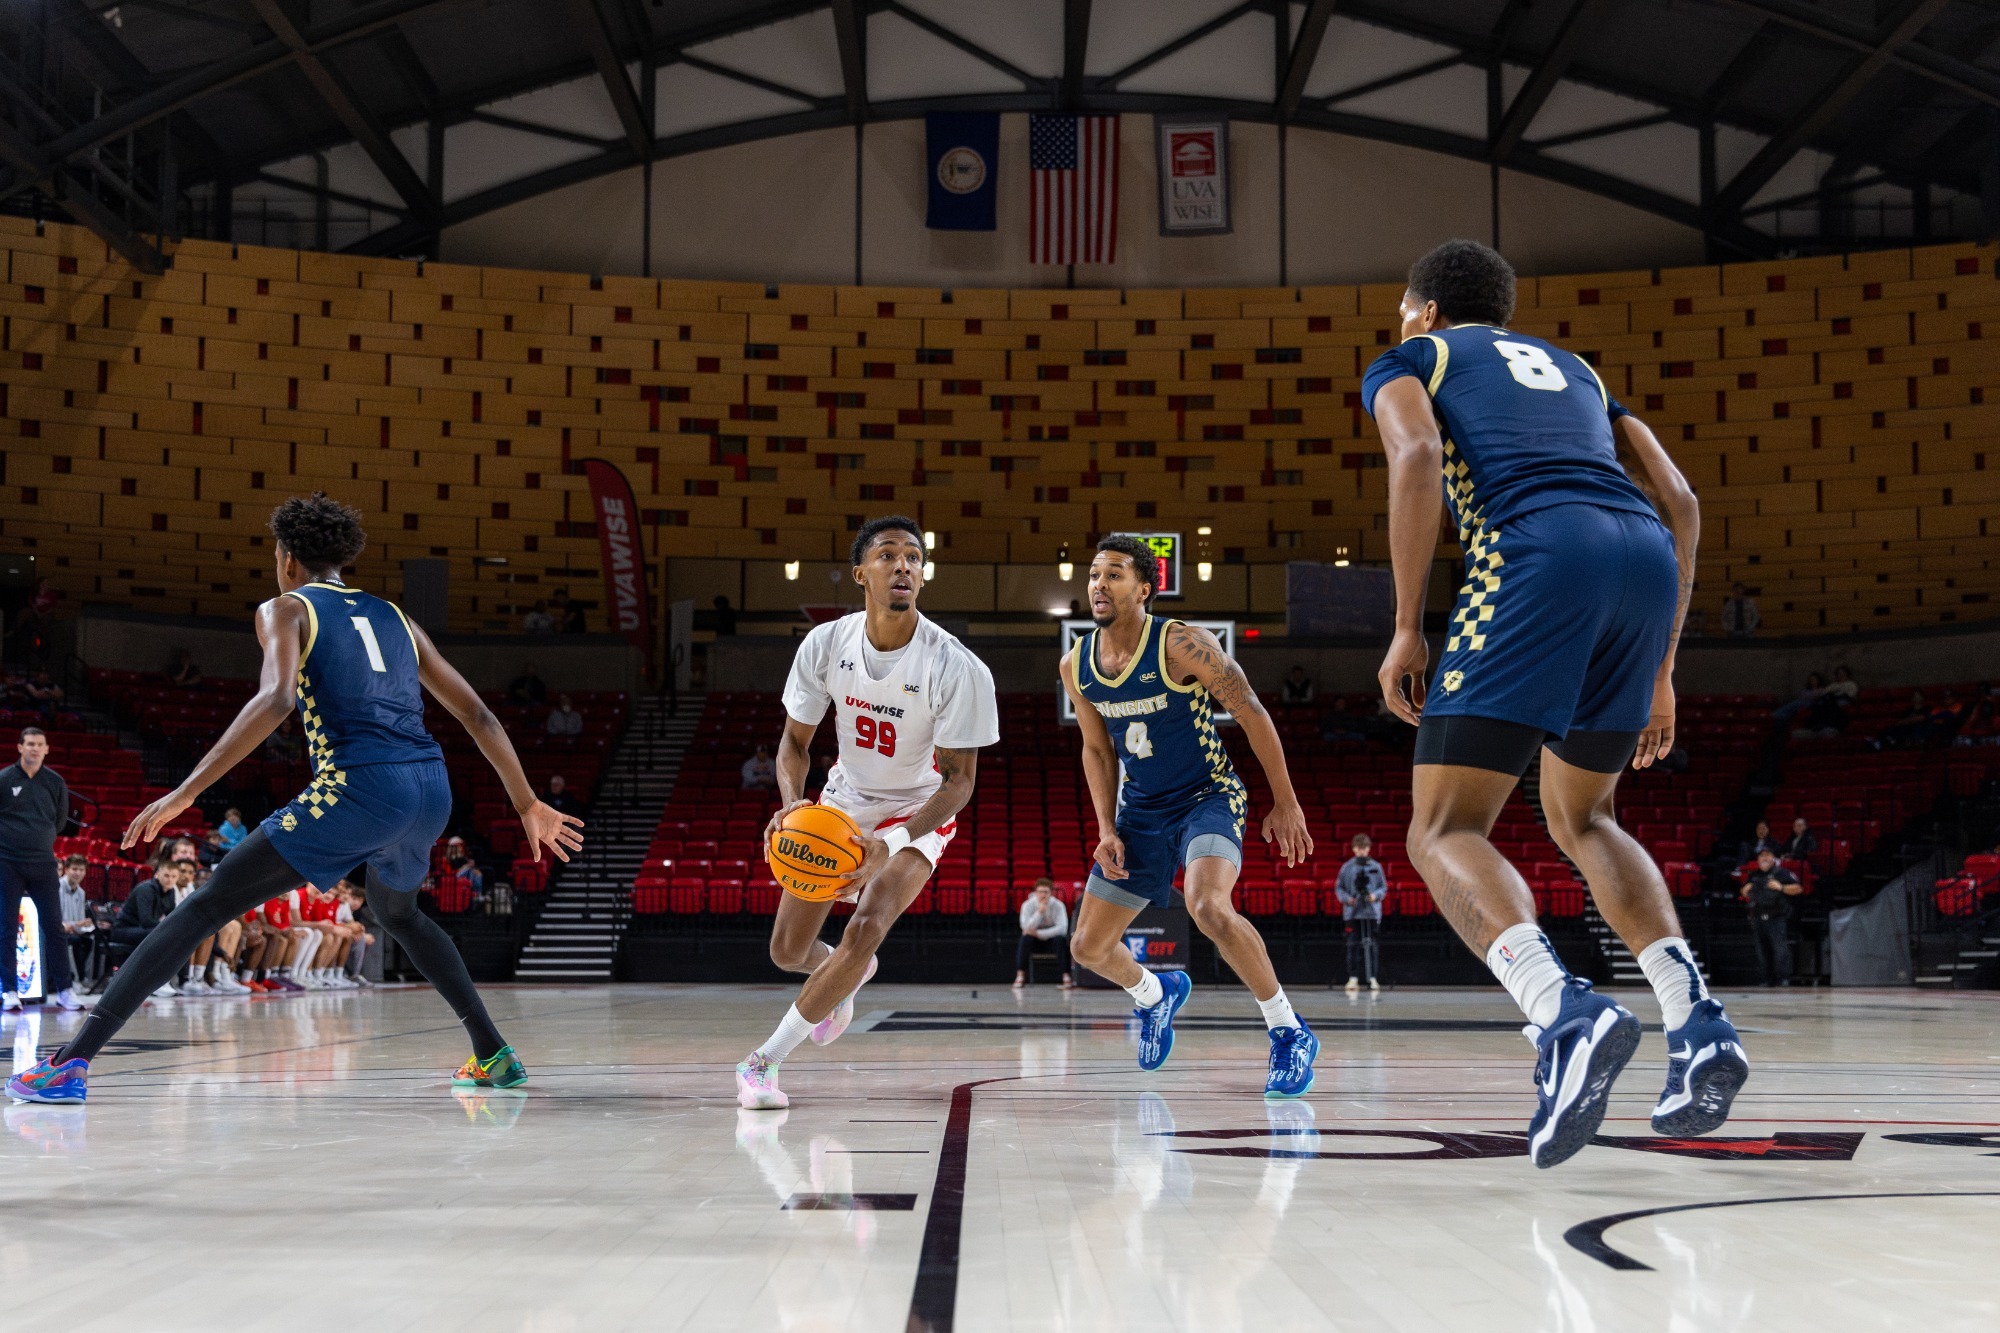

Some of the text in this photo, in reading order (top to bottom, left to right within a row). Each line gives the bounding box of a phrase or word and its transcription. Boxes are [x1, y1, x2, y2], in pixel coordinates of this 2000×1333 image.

[1173, 182, 1216, 199] UVA
[1173, 204, 1217, 221] WISE
[1492, 340, 1568, 392] 8
[602, 496, 640, 631] UVAWISE
[350, 616, 387, 673] 1
[903, 684, 920, 694] SAC
[1141, 671, 1157, 681] SAC
[855, 715, 896, 758] 99
[1125, 721, 1153, 760] 4
[778, 837, 838, 870] Wilson
[781, 874, 818, 893] EVO
